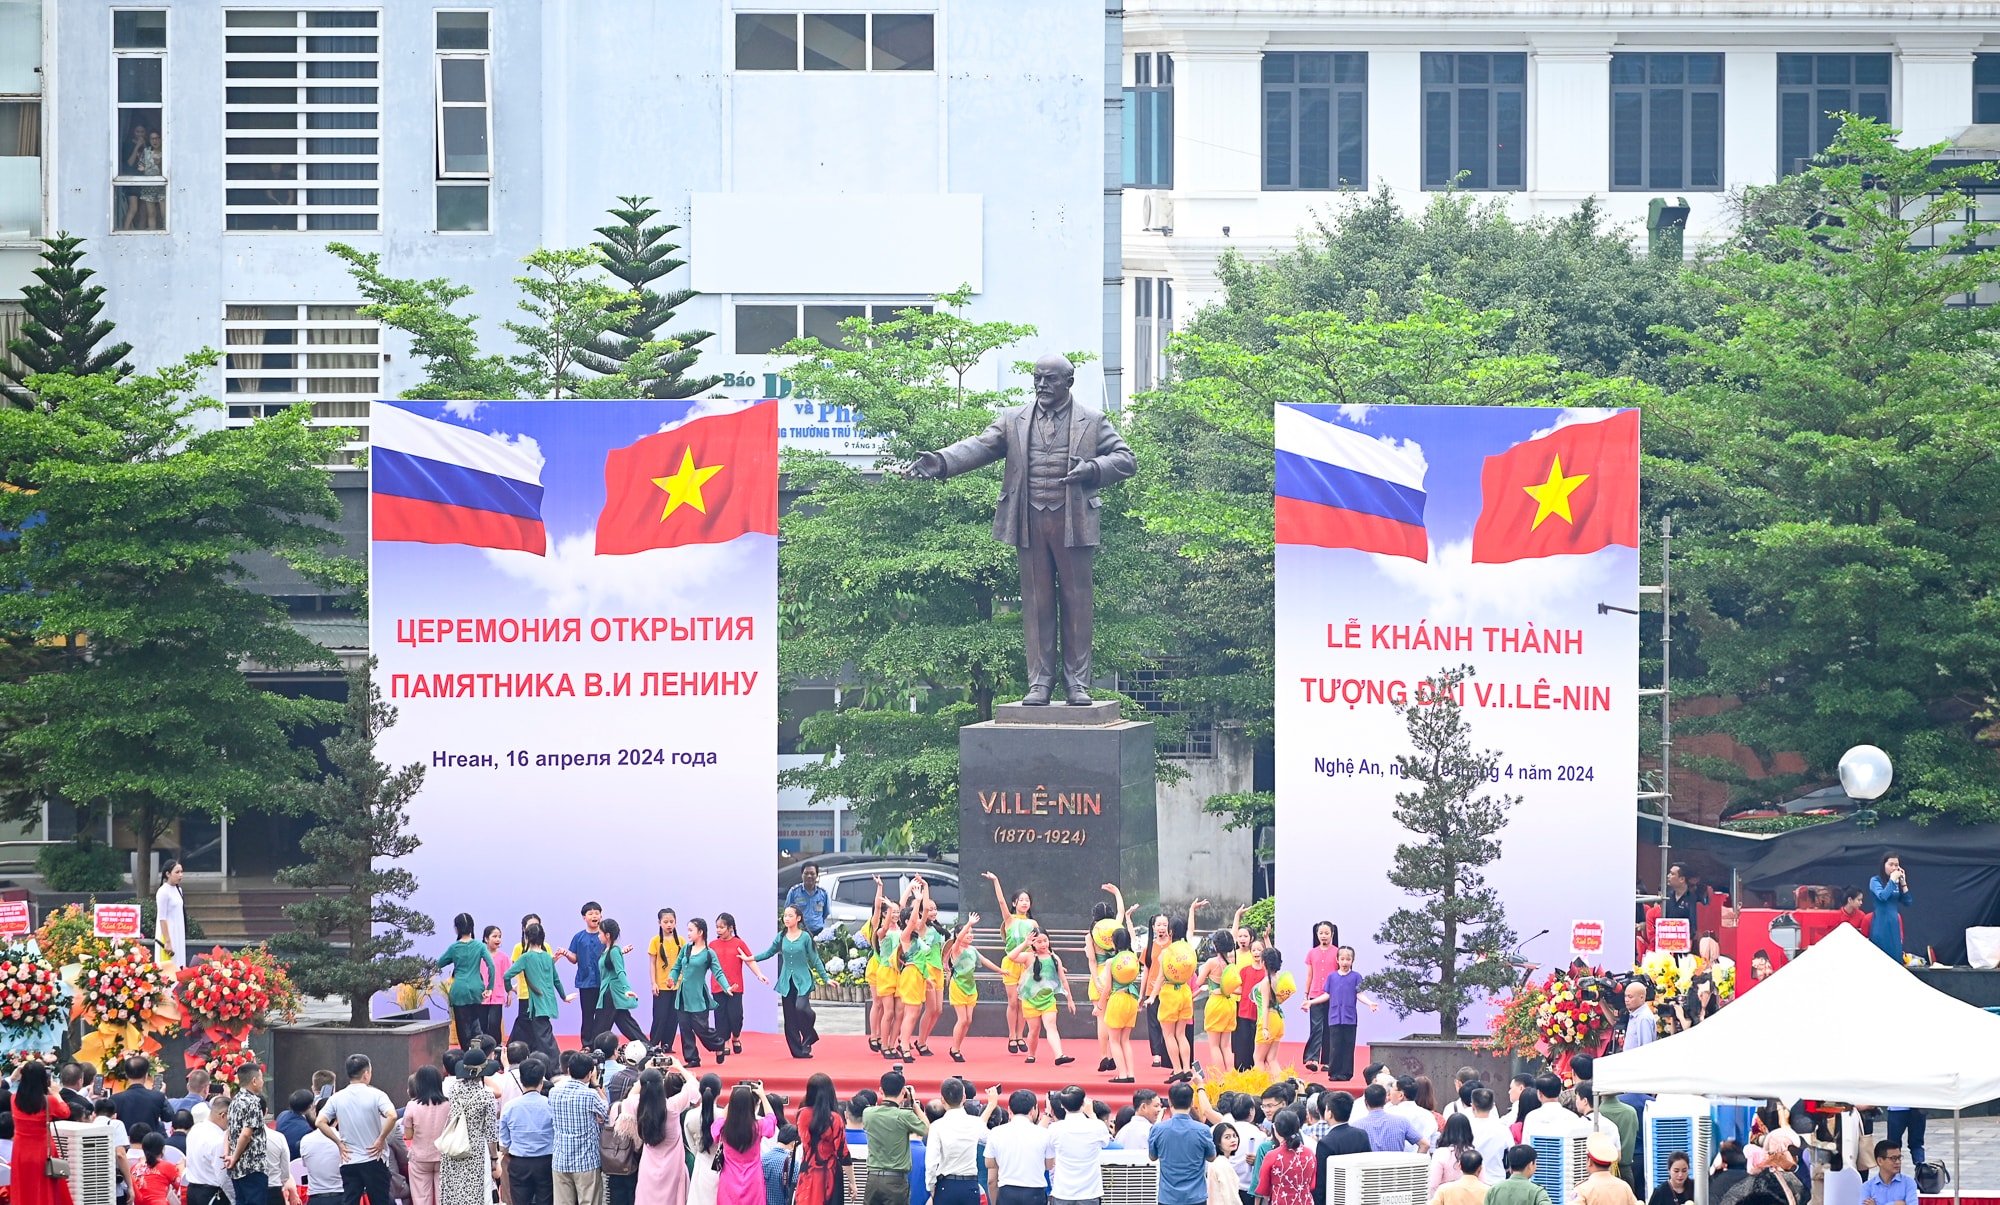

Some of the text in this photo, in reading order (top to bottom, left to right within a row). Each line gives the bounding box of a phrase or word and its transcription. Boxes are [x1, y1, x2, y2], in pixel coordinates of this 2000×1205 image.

[723, 371, 756, 388] Báo
[794, 400, 815, 415] và
[790, 423, 830, 439] THƯỜNG
[832, 424, 851, 438] TRÚ
[397, 616, 754, 648] ЦЕРЕМОНИЯ ОТКРЫТИЯ
[1327, 618, 1583, 655] LỄ KHÁNH THÀNH
[391, 671, 759, 698] ПАМЯТНИКА В.И ЛЕНИНУ
[1300, 677, 1407, 711] TƯỢNG
[1474, 678, 1611, 711] V.I.LÊ-NIN
[432, 748, 717, 771] Нгеан, 16 апреля 2024 года
[1315, 757, 1355, 778] Nghệ
[1359, 759, 1384, 778] An,
[1505, 763, 1514, 779] 4
[1520, 764, 1552, 781] năm
[1558, 765, 1595, 782] 2024
[978, 785, 1101, 816] V.I.LÊ-NIN
[994, 826, 1087, 846] (1870-1924)
